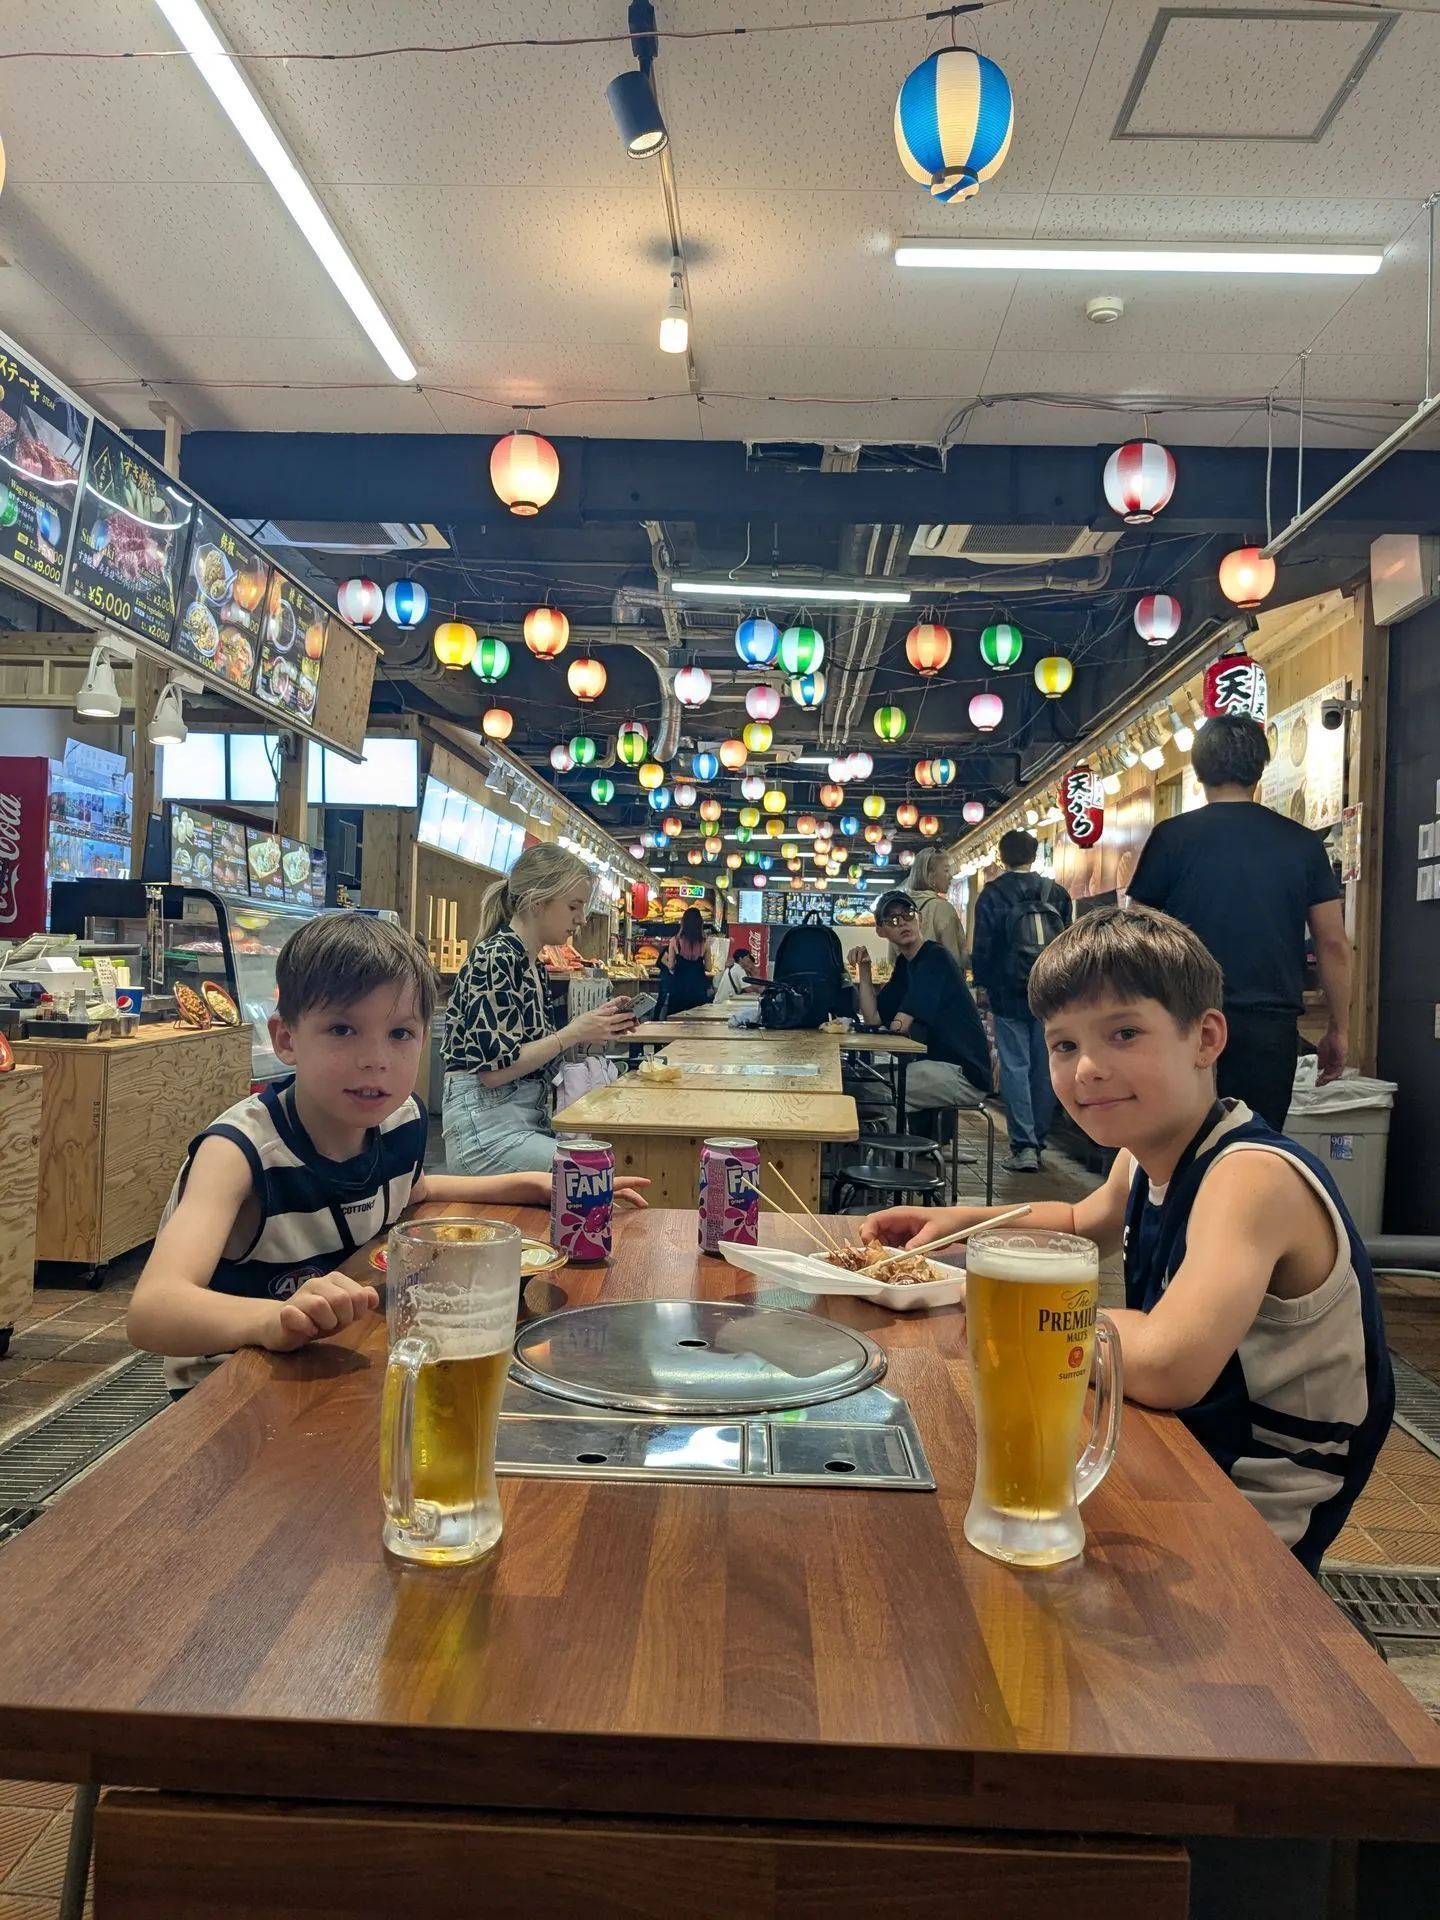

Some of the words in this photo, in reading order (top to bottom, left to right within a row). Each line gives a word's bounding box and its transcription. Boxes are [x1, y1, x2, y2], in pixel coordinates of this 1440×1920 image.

[42, 395, 57, 411] STEAK
[11, 479, 28, 497] Wagyu
[88, 586, 131, 621] ¥5,000
[148, 624, 170, 642] ¥2,000
[1068, 773, 1093, 836] 天ぷら
[1061, 1289, 1090, 1310] The
